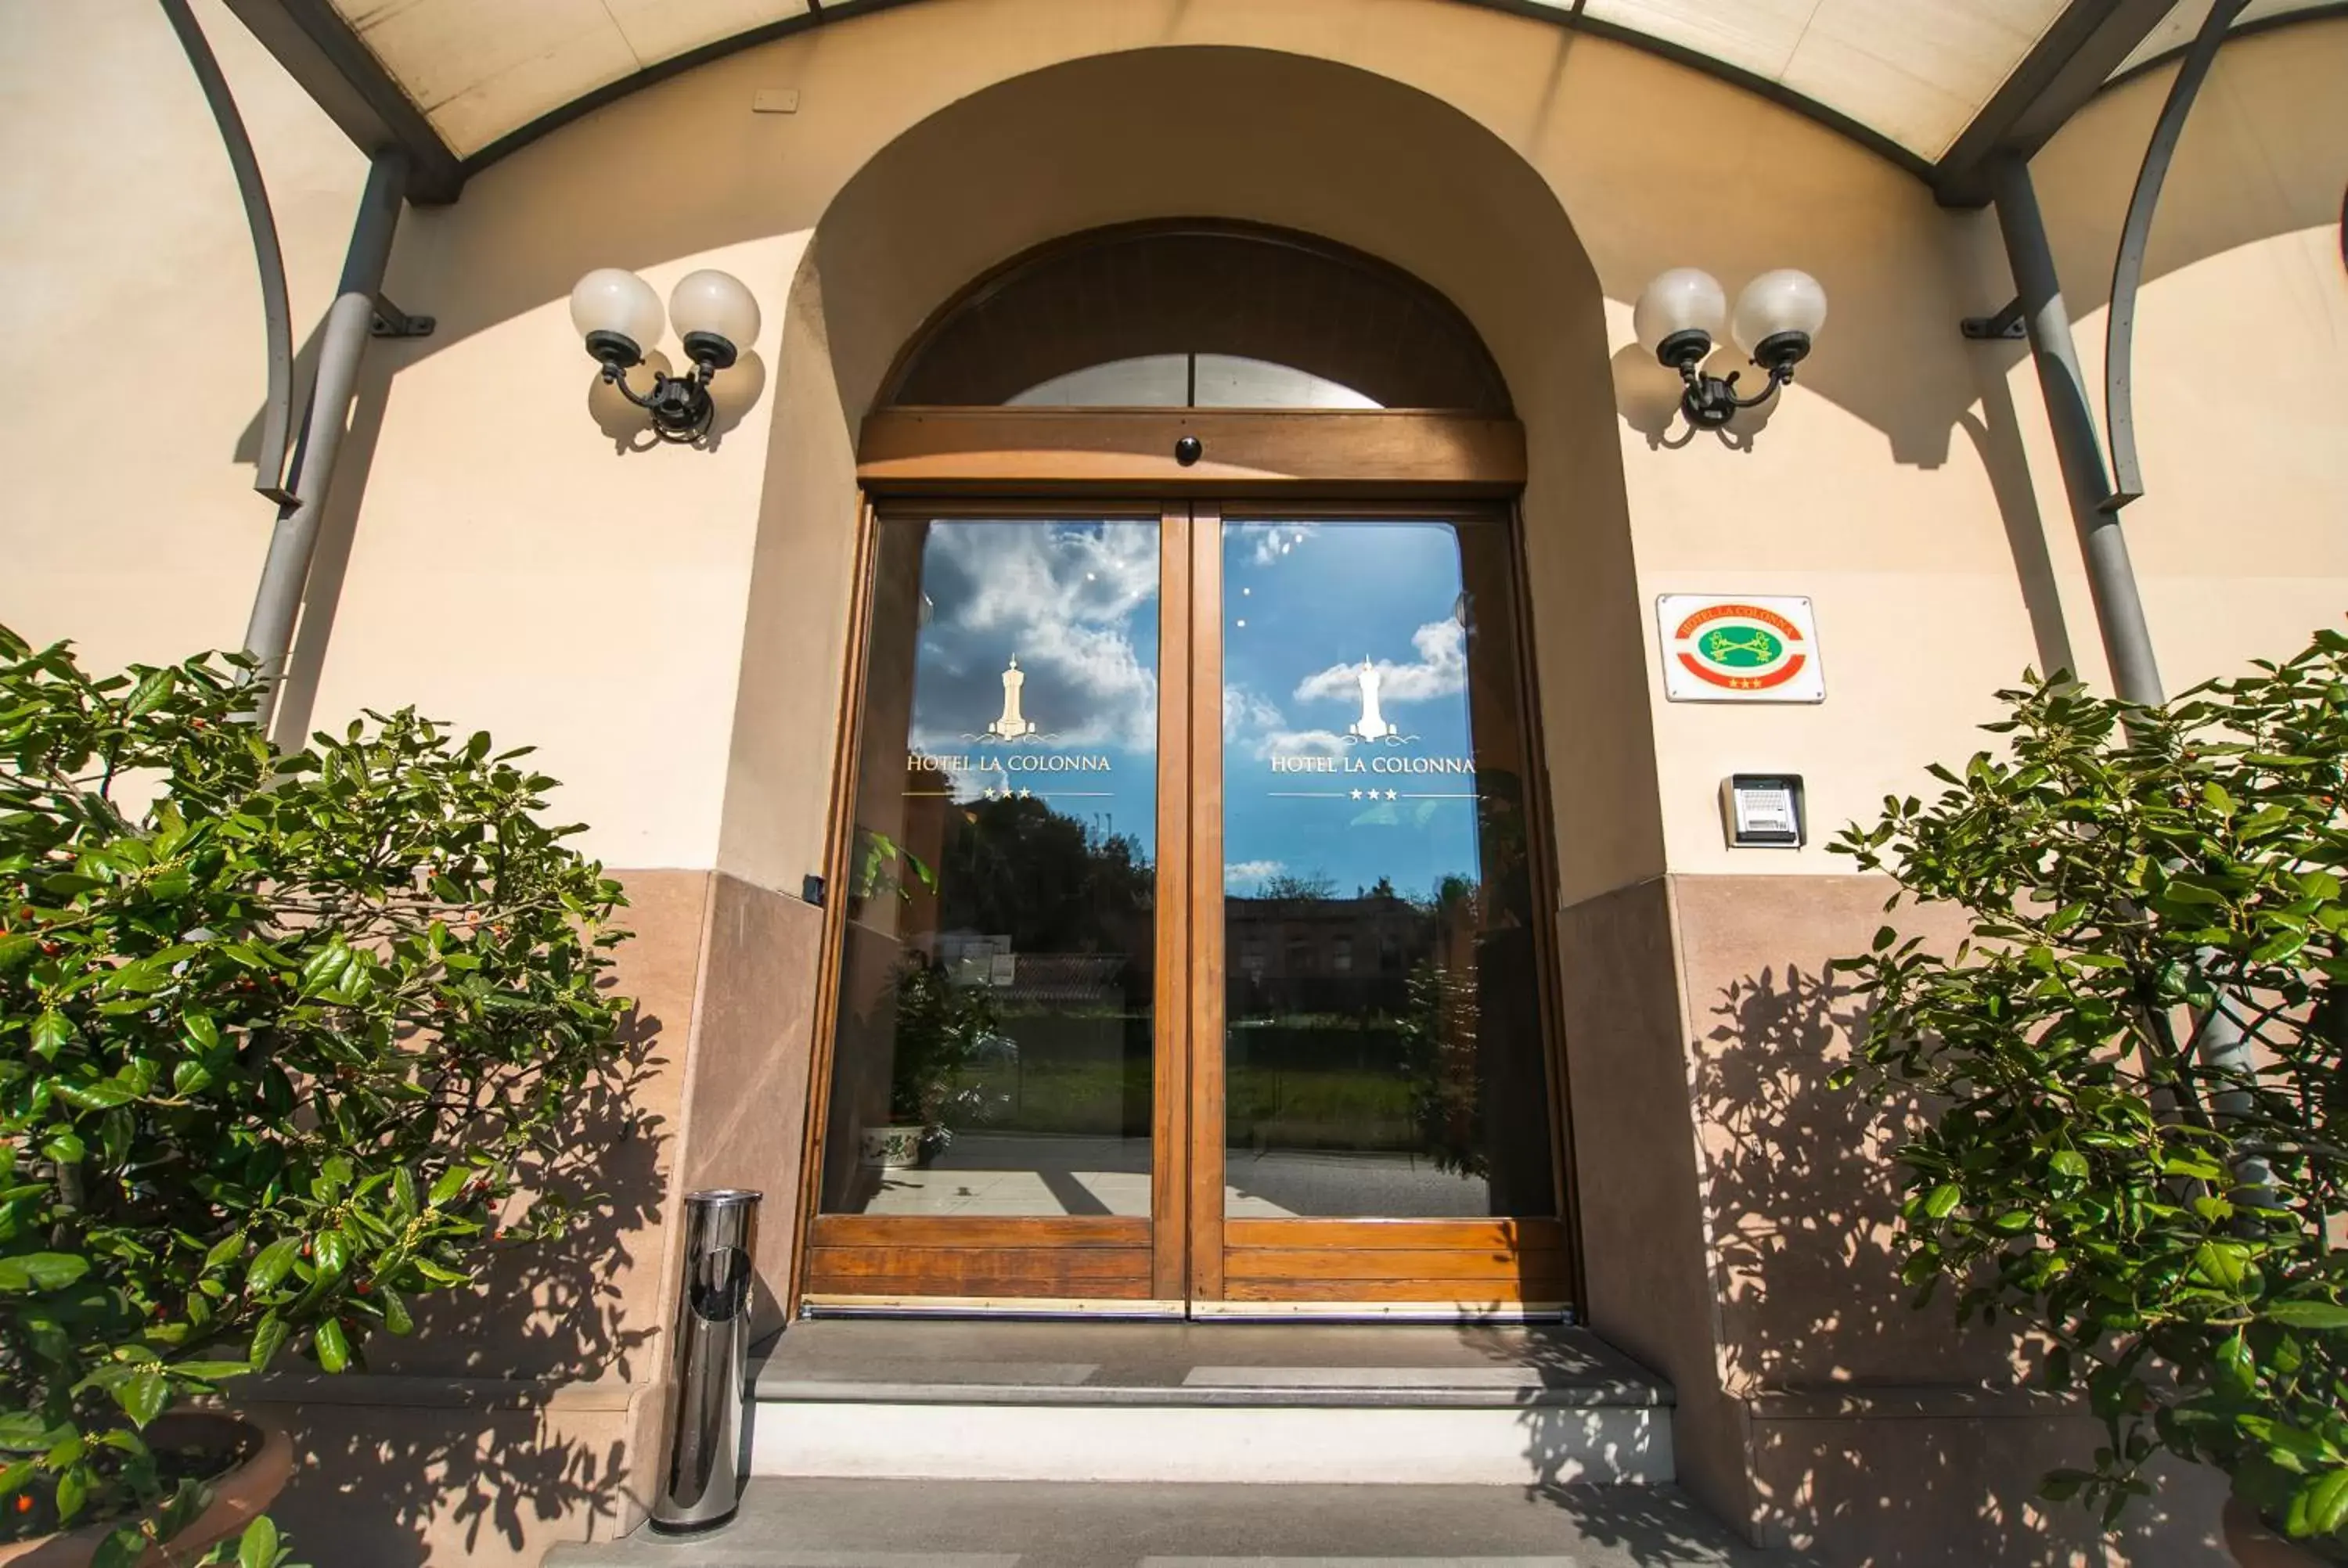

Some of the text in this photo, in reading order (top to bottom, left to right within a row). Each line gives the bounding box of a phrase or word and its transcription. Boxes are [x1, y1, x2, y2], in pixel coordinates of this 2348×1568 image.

[1681, 609, 1716, 634] HOTEL
[1718, 606, 1734, 615] LA
[907, 755, 1111, 771] HOTEL LA COLONNA
[1271, 757, 1476, 773] HOTEL LA COLONNA
